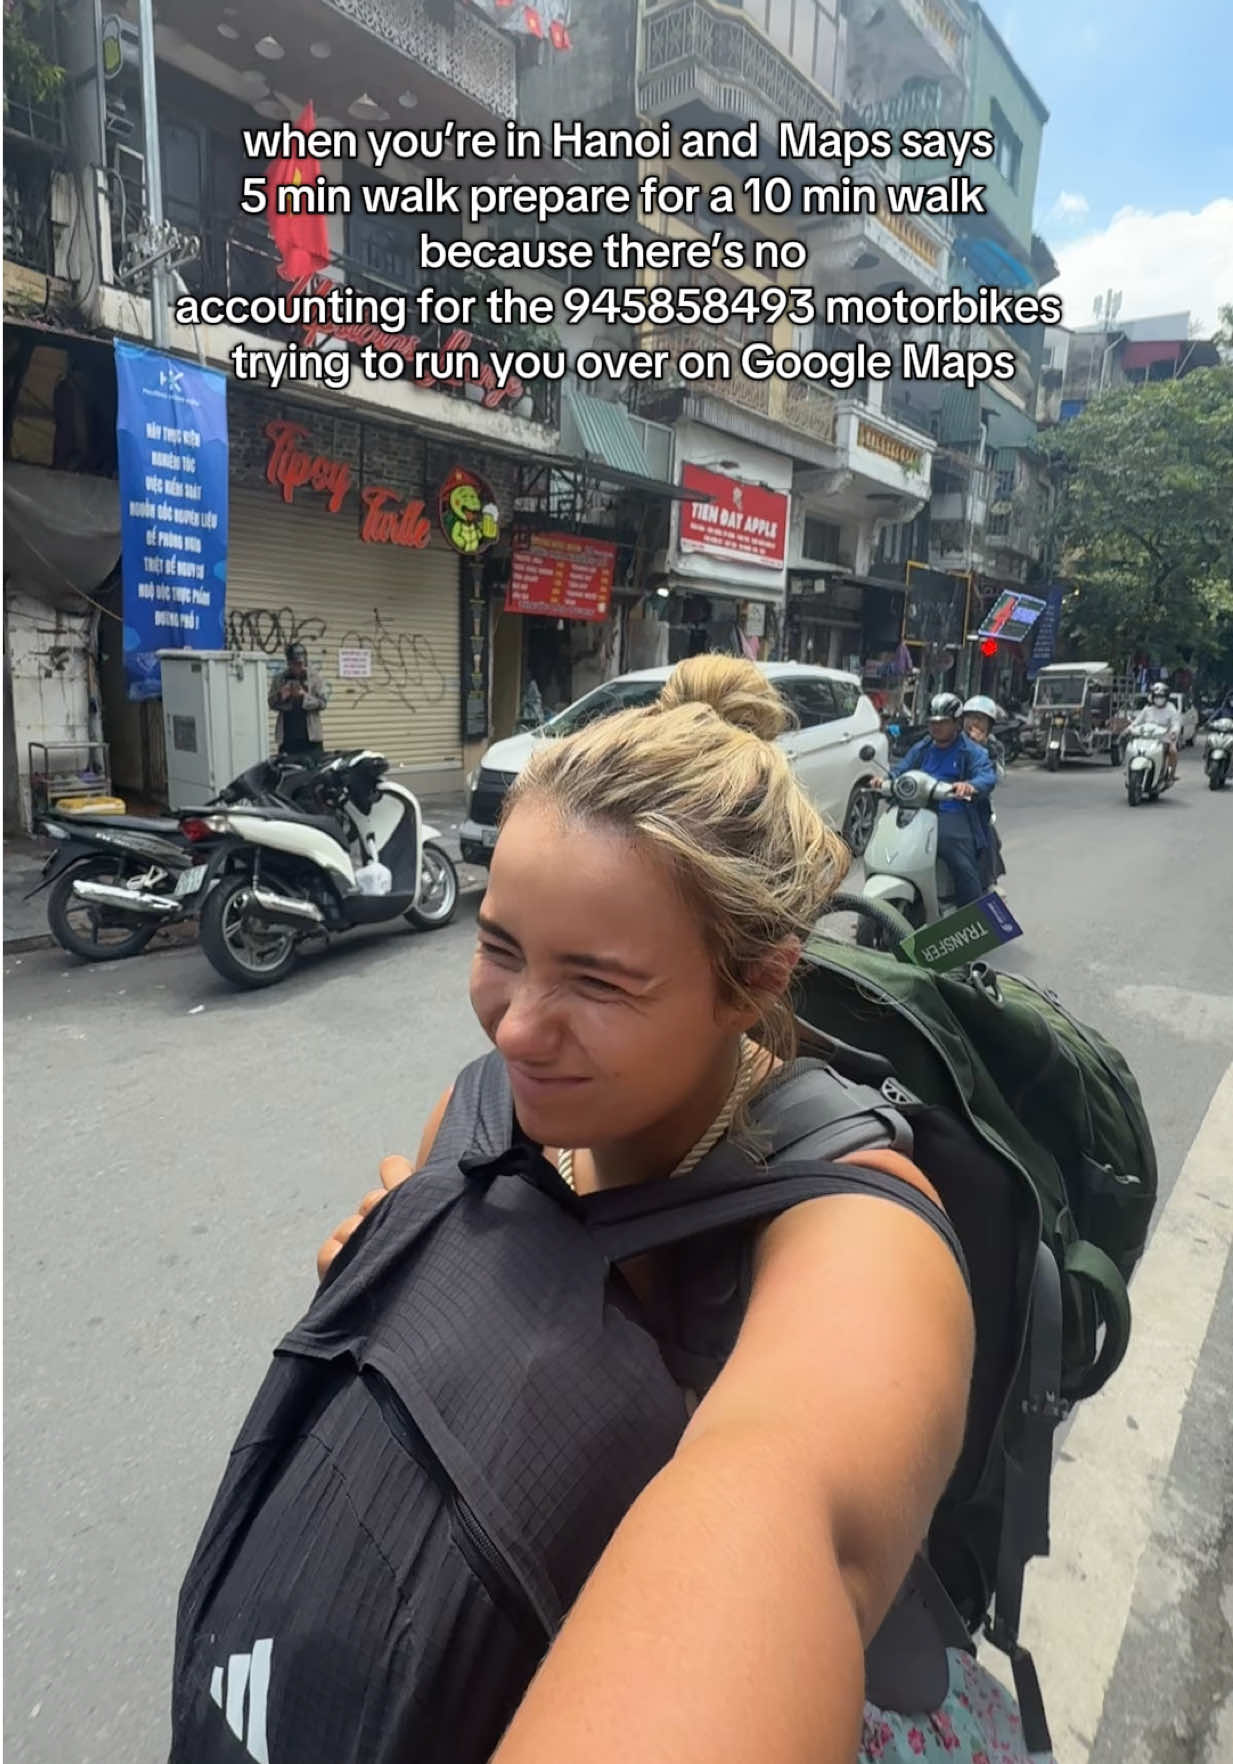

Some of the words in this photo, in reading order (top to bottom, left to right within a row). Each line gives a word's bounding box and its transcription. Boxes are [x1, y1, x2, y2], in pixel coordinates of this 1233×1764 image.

[266, 420, 350, 512] Tipsy
[361, 487, 431, 548] Turtle
[744, 515, 778, 539] APPLE
[921, 921, 989, 962] TRANSFER
